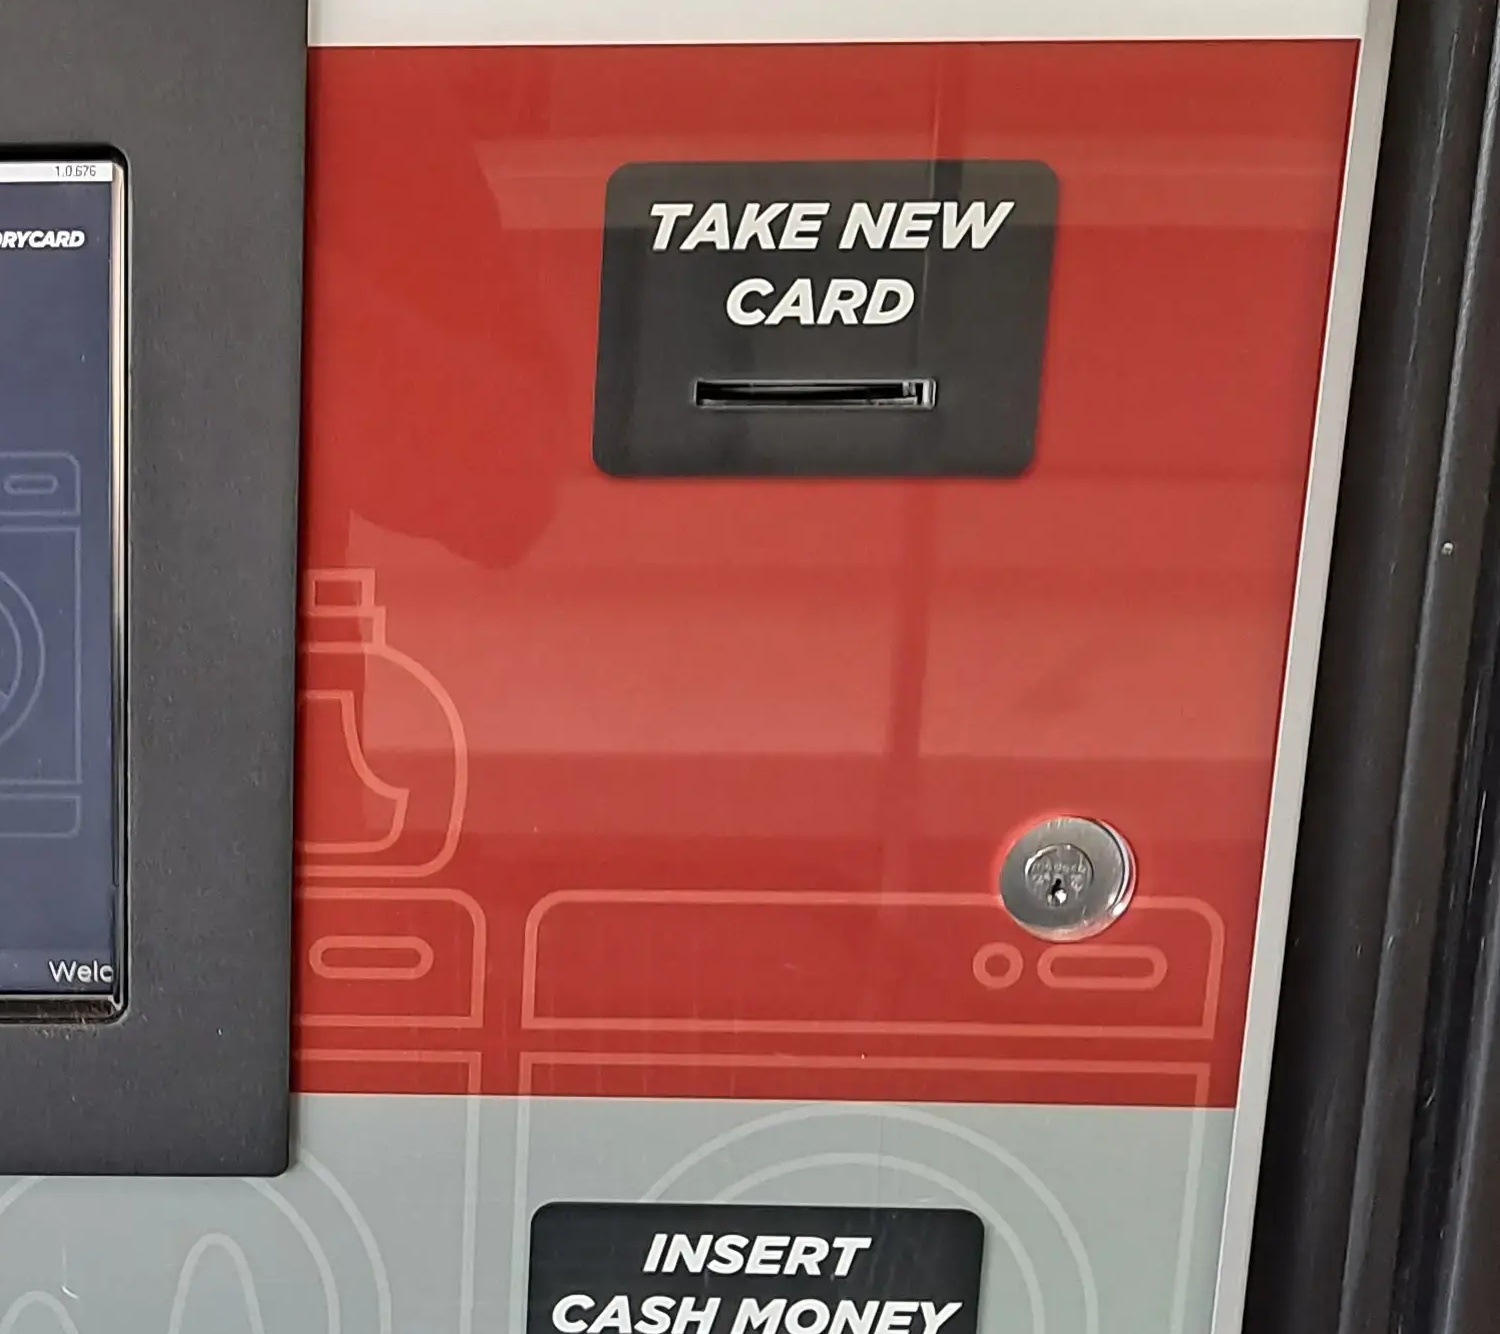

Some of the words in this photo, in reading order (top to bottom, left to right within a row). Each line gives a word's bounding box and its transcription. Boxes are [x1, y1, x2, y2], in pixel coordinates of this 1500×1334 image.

[651, 202, 830, 251] TAKE
[840, 202, 1014, 250] NEW
[726, 279, 915, 326] CARD
[48, 960, 113, 983] Welc
[643, 1234, 873, 1277] INSERT
